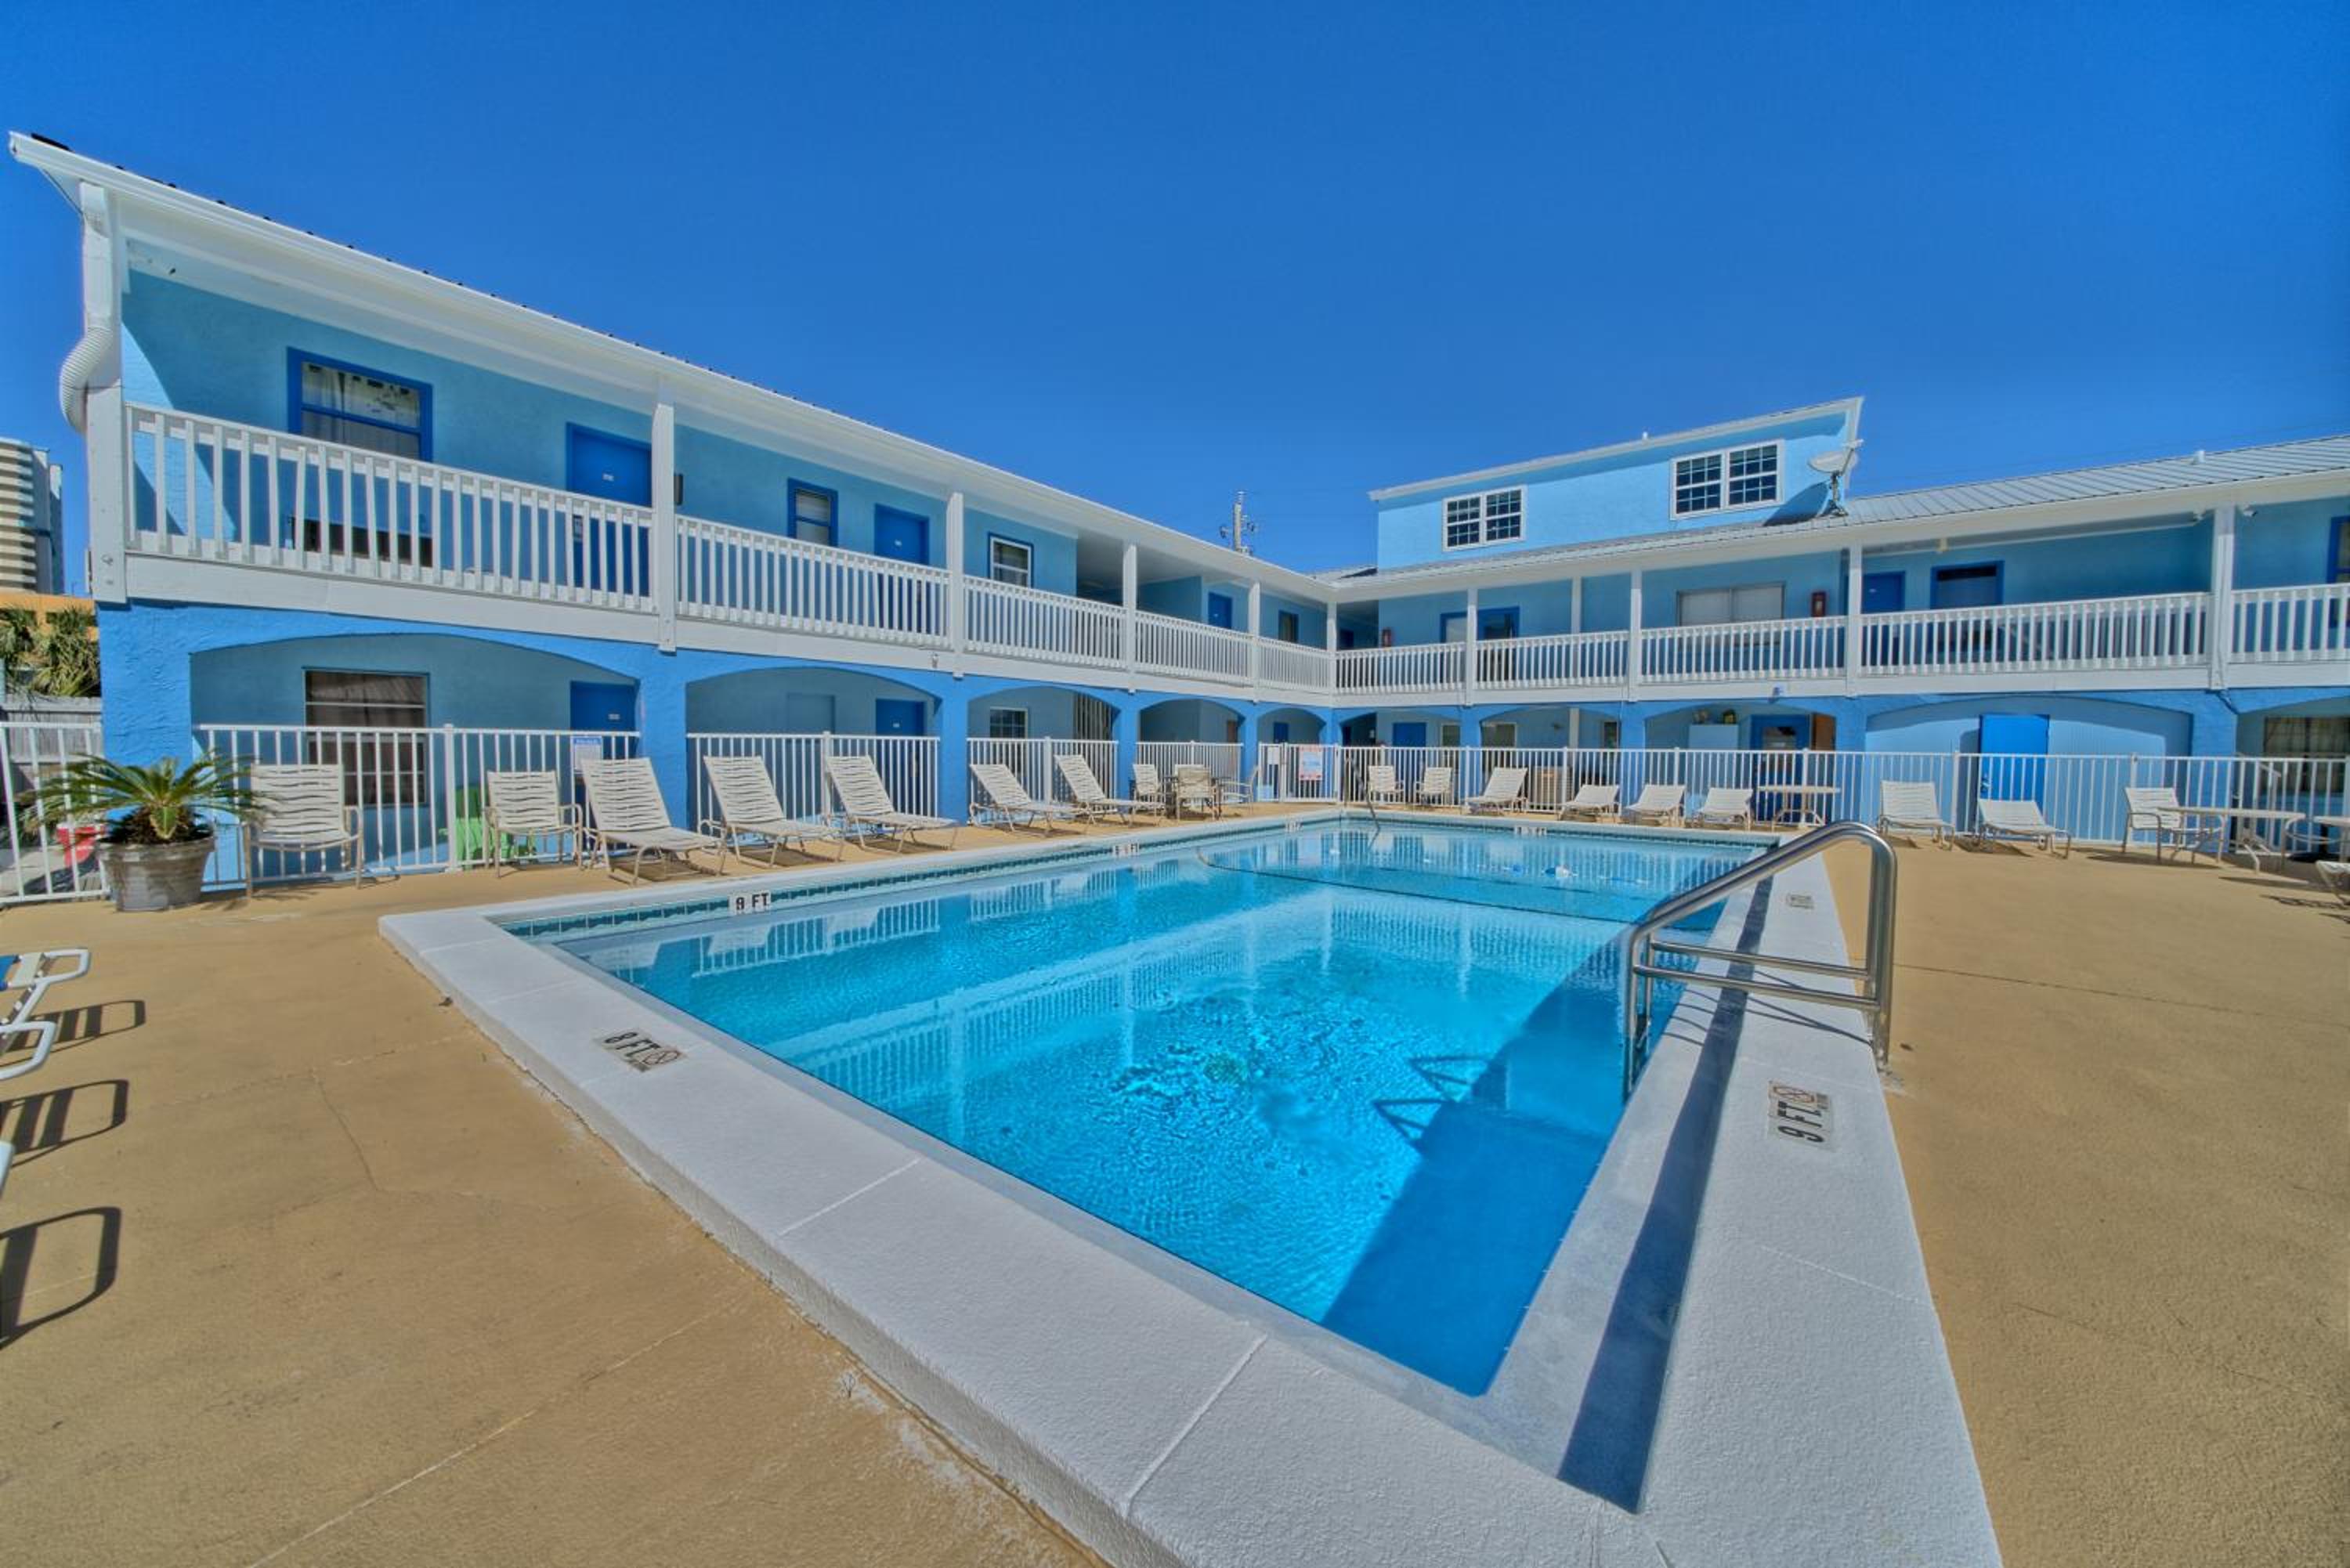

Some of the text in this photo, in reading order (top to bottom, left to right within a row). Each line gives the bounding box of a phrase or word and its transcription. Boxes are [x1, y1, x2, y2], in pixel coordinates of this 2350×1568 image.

[752, 892, 769, 908] FT
[615, 1039, 662, 1057] FT
[1777, 1100, 1825, 1143] 9 FT
